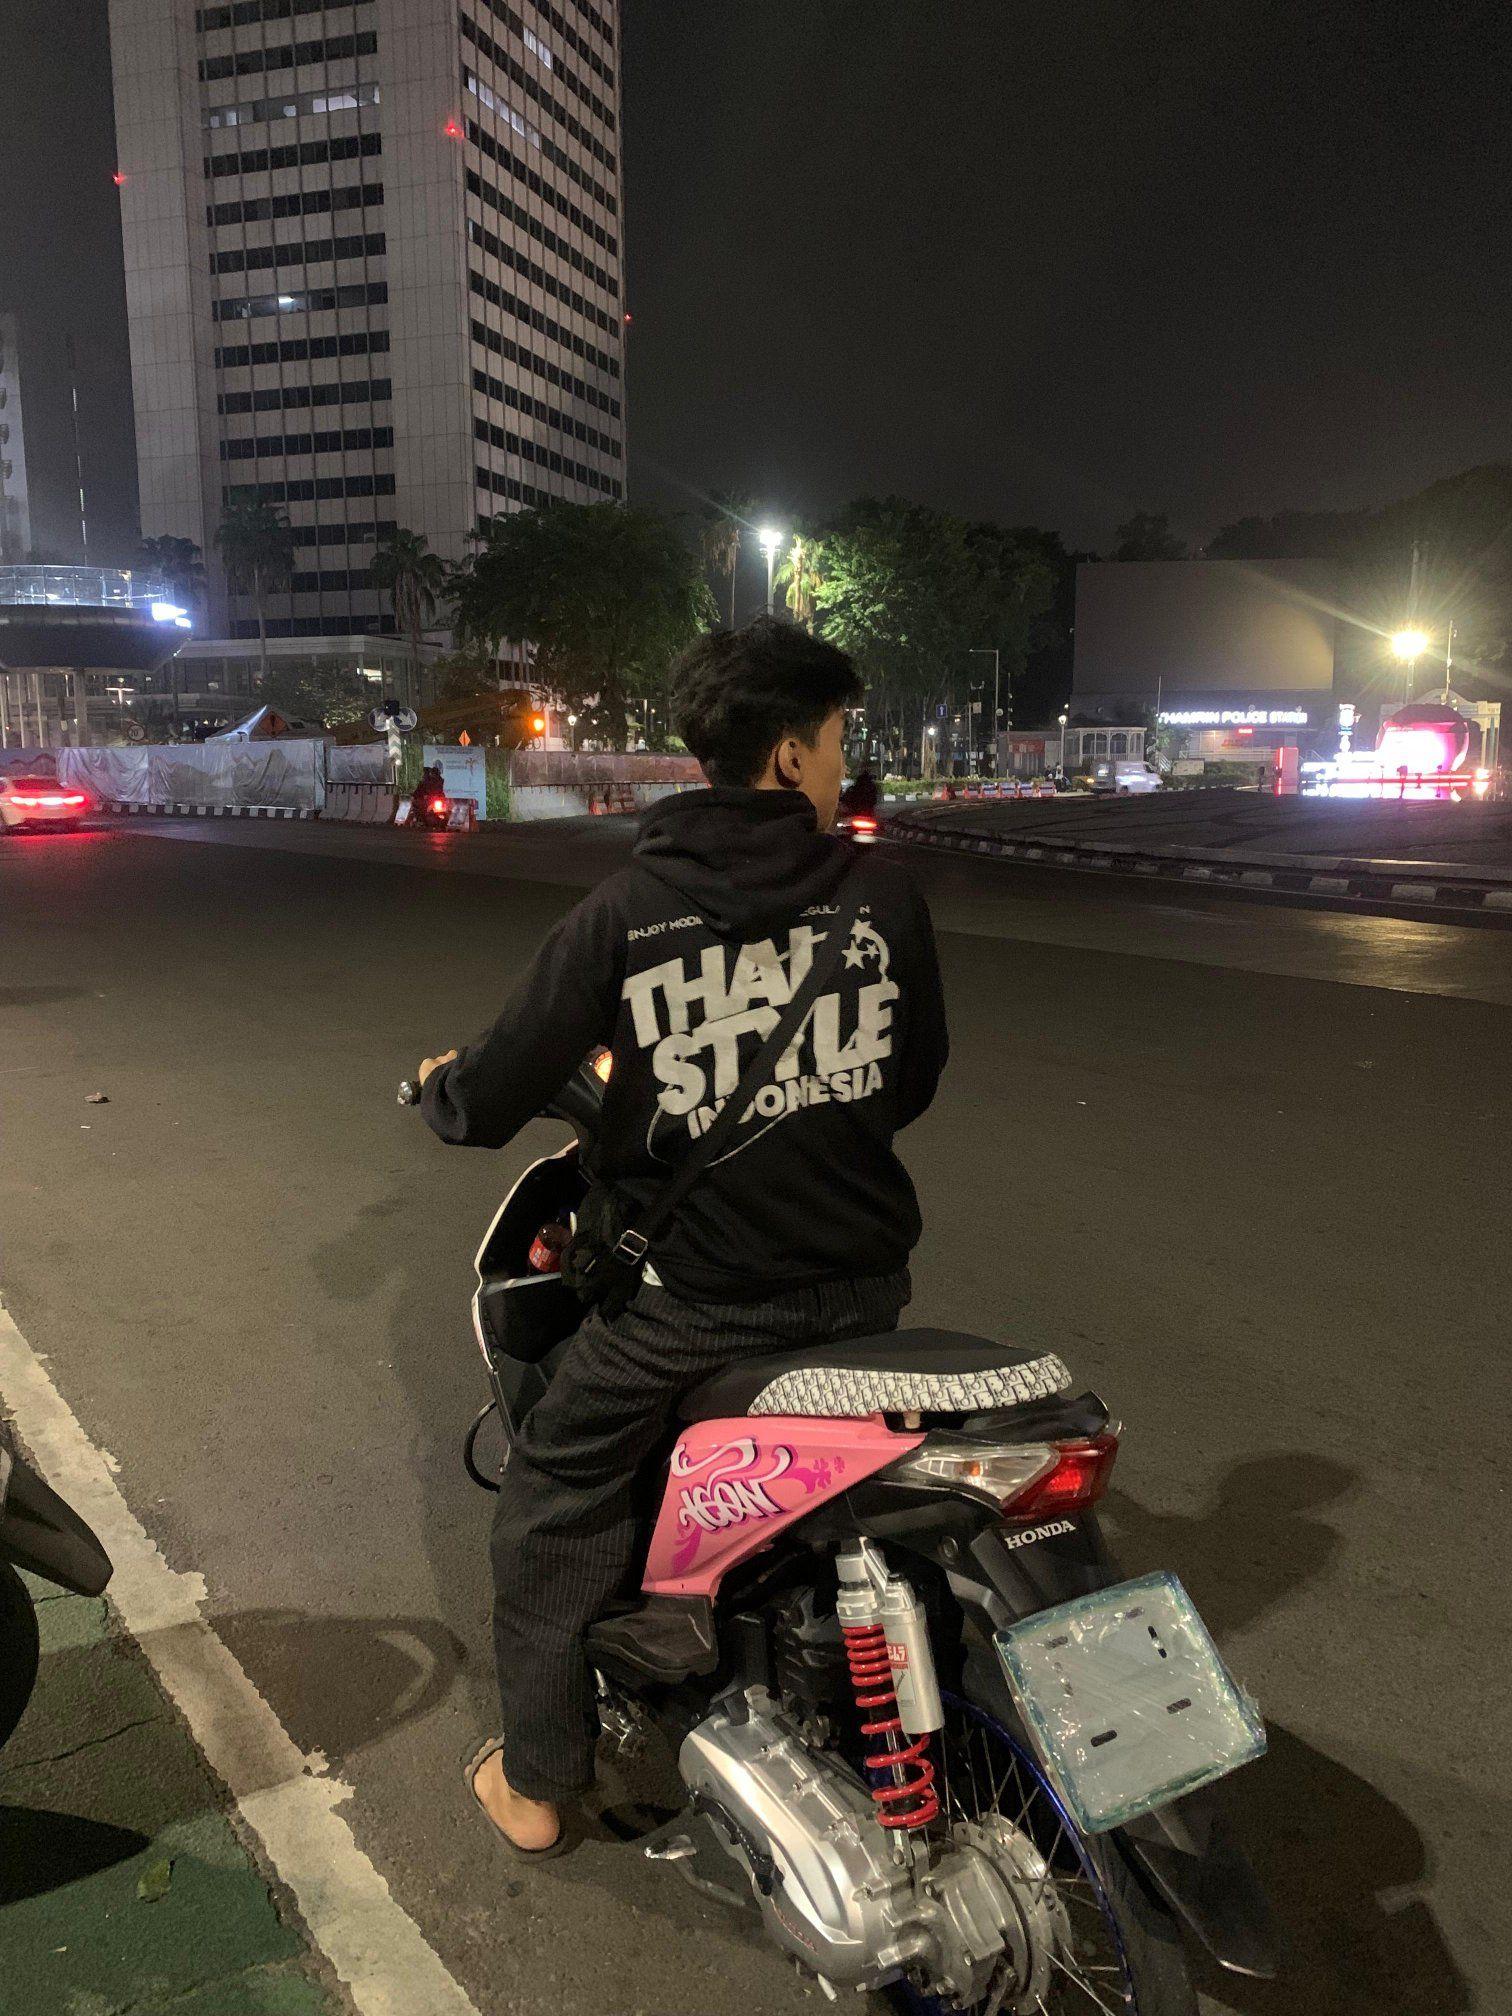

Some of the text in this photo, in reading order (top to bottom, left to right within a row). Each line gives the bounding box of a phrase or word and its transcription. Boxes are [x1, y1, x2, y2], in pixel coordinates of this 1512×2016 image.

[1222, 711, 1268, 724] POLICE
[627, 921, 667, 941] ENJOY
[621, 925, 829, 1049] THAT
[687, 1061, 883, 1139] INONESIA
[1004, 1520, 1076, 1550] HONDA
